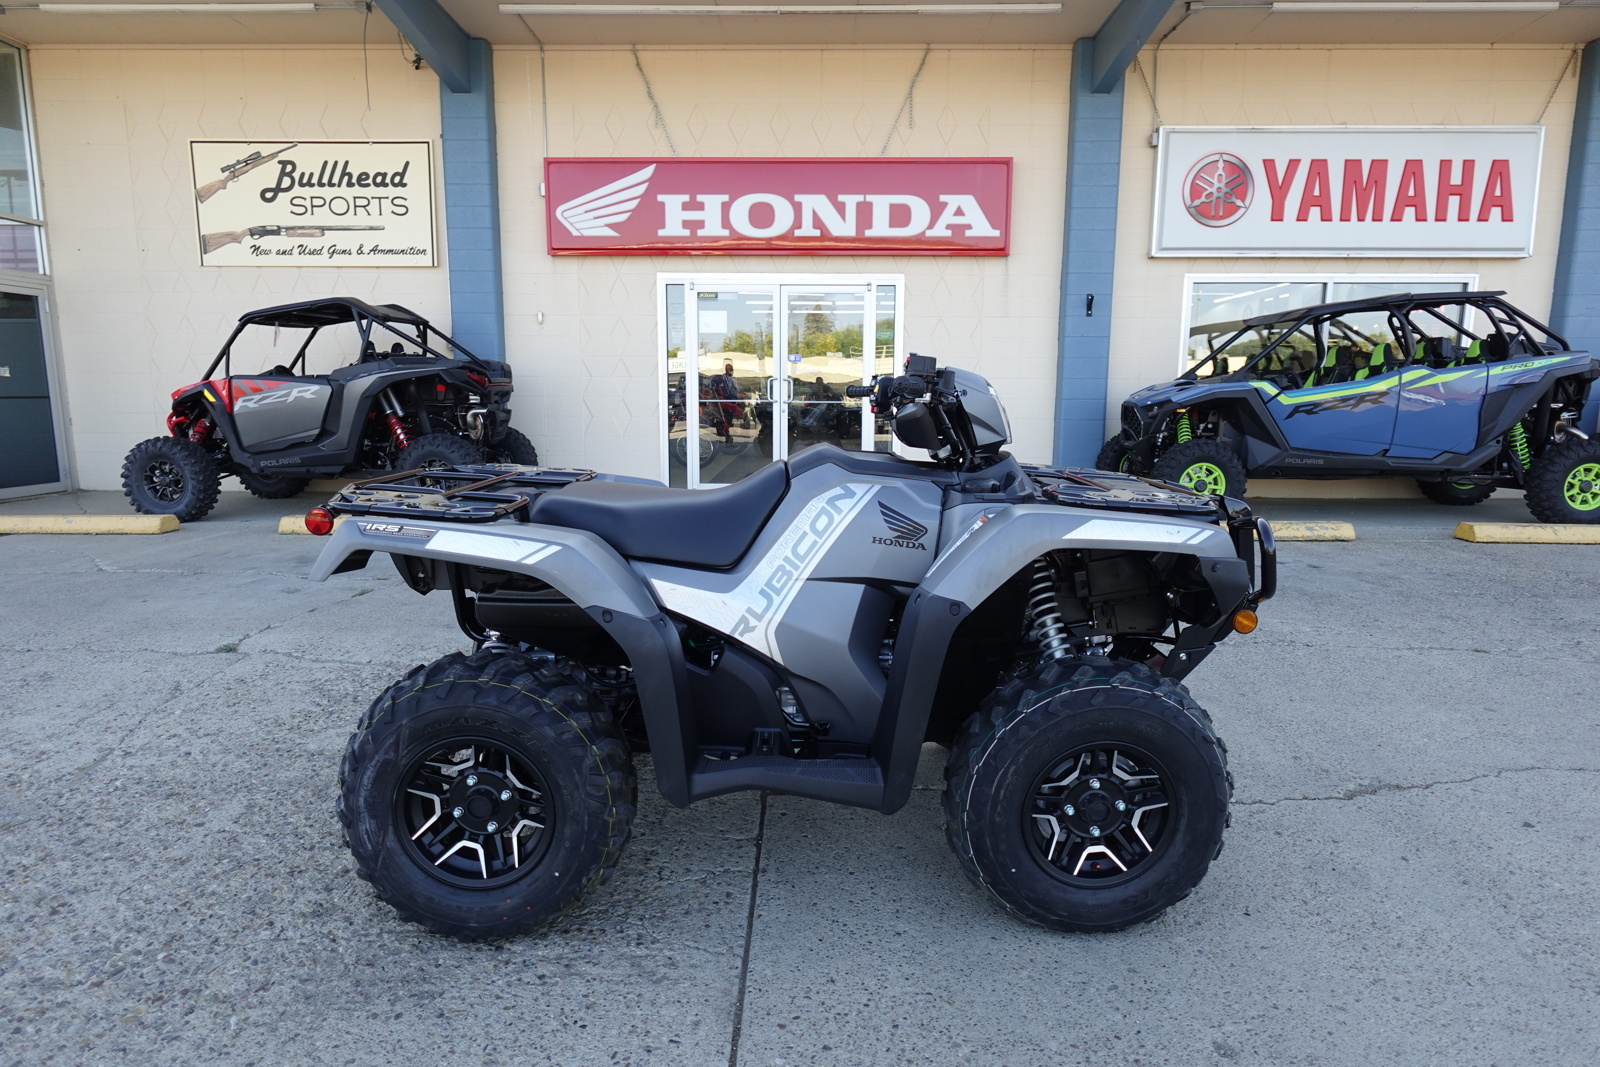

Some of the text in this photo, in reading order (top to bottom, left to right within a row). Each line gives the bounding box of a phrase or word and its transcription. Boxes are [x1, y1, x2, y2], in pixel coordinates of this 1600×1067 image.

[260, 160, 410, 203] Bullhead
[1262, 159, 1514, 222] YAMAHA
[290, 196, 409, 216] SPORTS
[657, 193, 1000, 238] HONDA
[249, 244, 428, 259] New and Used Guns & Ammunition
[1501, 362, 1535, 371] PRO
[233, 385, 321, 412] RZR
[1283, 391, 1391, 421] RZR
[260, 458, 301, 467] POLARIS
[366, 523, 401, 532] IRS
[871, 536, 927, 551] HONDA
[727, 483, 858, 639] RUBICON
